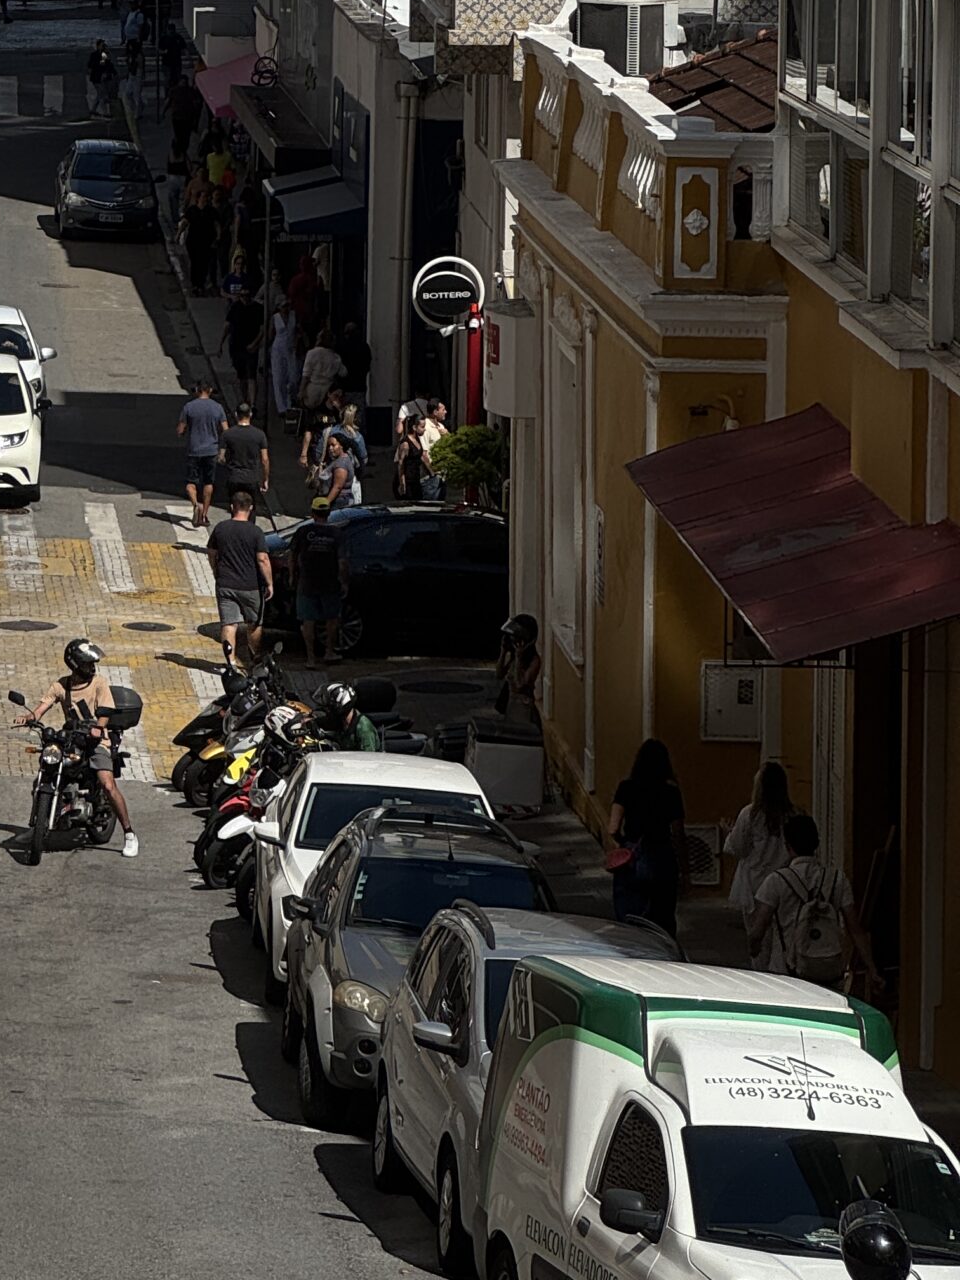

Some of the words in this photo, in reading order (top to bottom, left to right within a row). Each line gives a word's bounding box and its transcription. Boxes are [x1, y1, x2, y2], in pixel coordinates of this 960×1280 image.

[422, 290, 471, 300] BOTTERO
[704, 1077, 772, 1085] ELEVACON
[863, 1087, 895, 1099] LTDA
